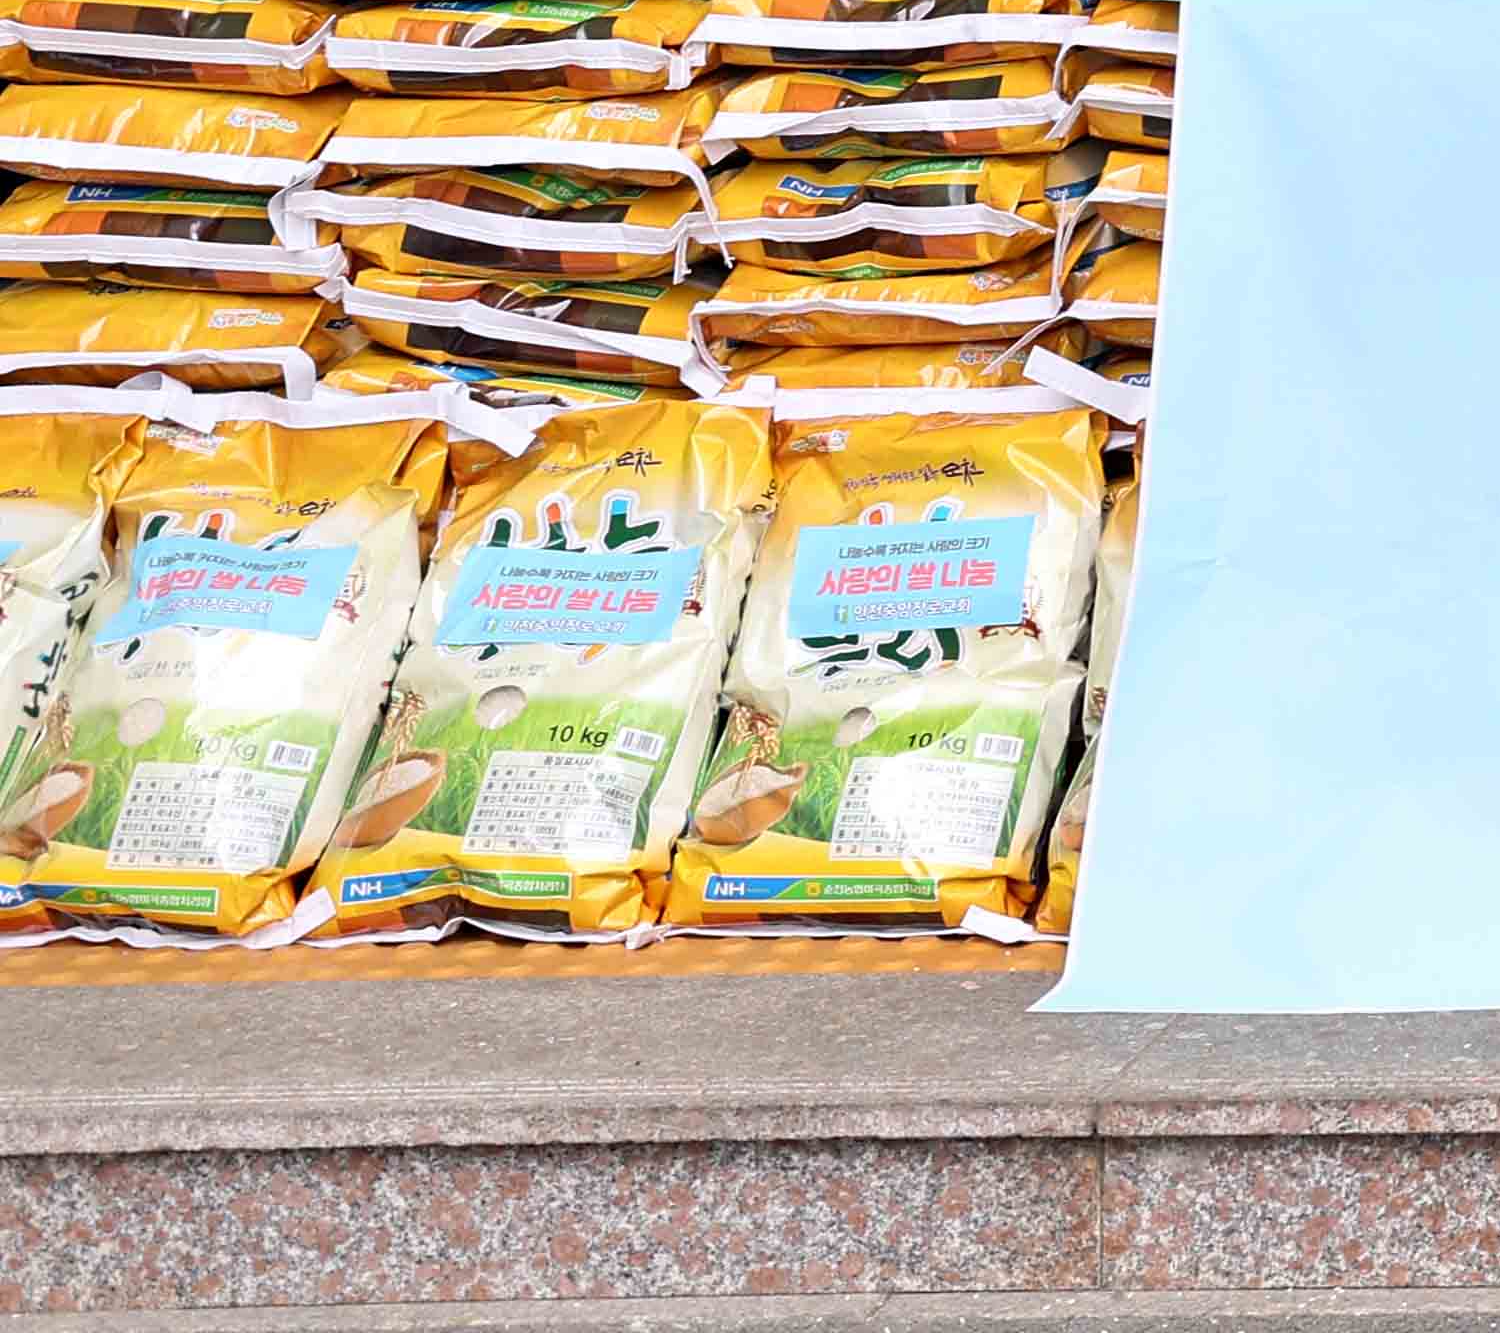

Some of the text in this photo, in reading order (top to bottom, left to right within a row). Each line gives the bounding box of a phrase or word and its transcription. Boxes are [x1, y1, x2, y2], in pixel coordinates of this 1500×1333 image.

[78, 186, 113, 199] NH
[789, 181, 823, 197] NH
[817, 559, 997, 596] 사랑의 쌀 나눔
[471, 584, 661, 613] 사랑의 쌀 나눔
[549, 725, 608, 747] 10 kg
[907, 732, 967, 755] 10 kg
[231, 737, 258, 761] kg
[350, 883, 382, 897] NH
[715, 883, 745, 895] NH
